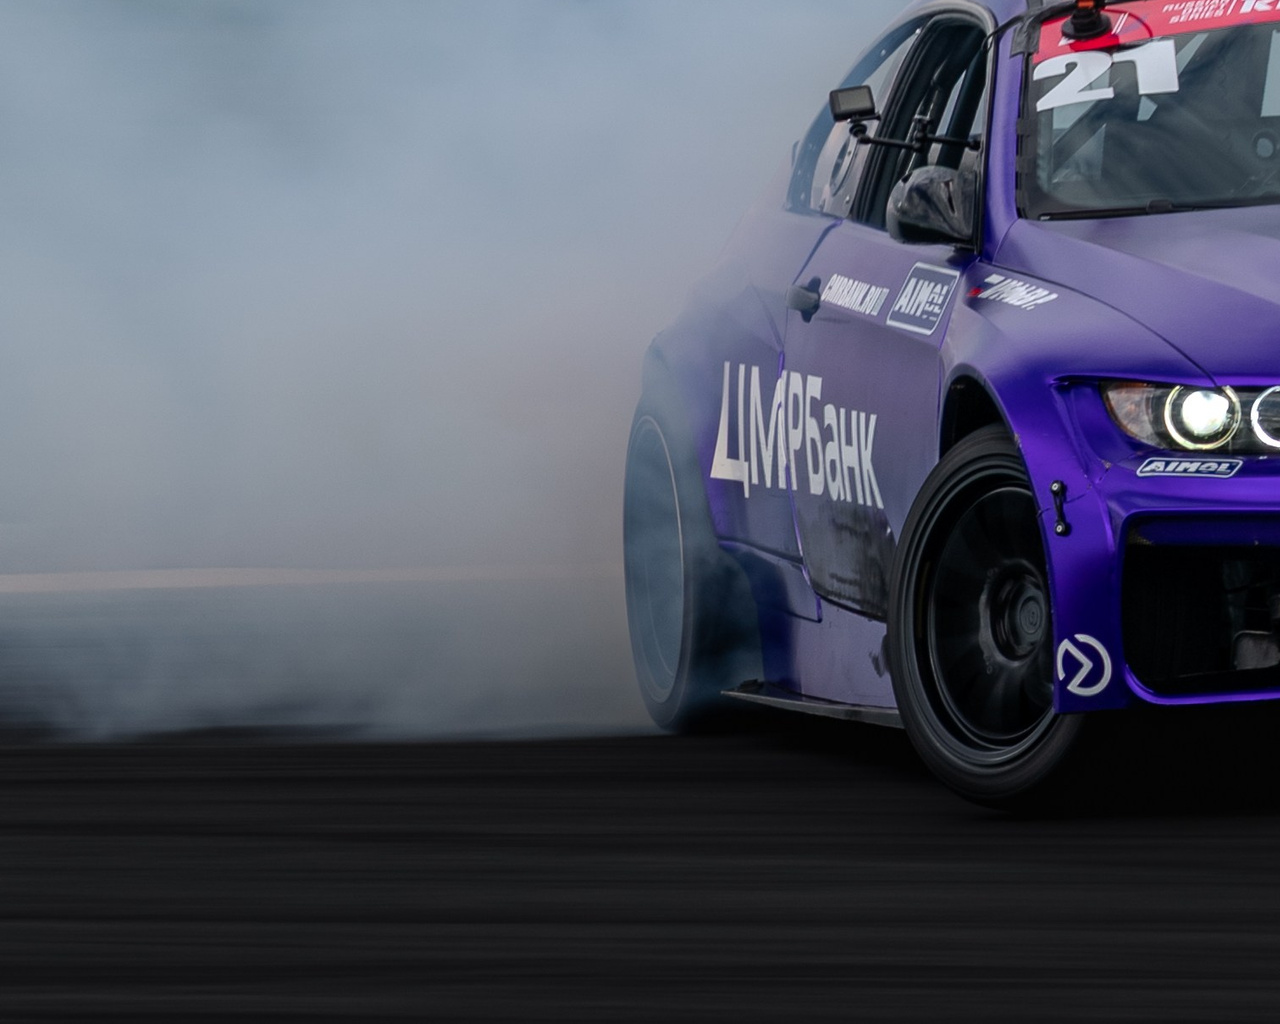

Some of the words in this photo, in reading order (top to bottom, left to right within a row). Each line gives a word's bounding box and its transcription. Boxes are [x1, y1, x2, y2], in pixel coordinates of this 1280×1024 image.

[1169, 8, 1224, 24] SERIES
[1033, 39, 1179, 112] 21
[710, 361, 884, 509] ЦМРБанк
[1141, 460, 1233, 473] AIMOL
